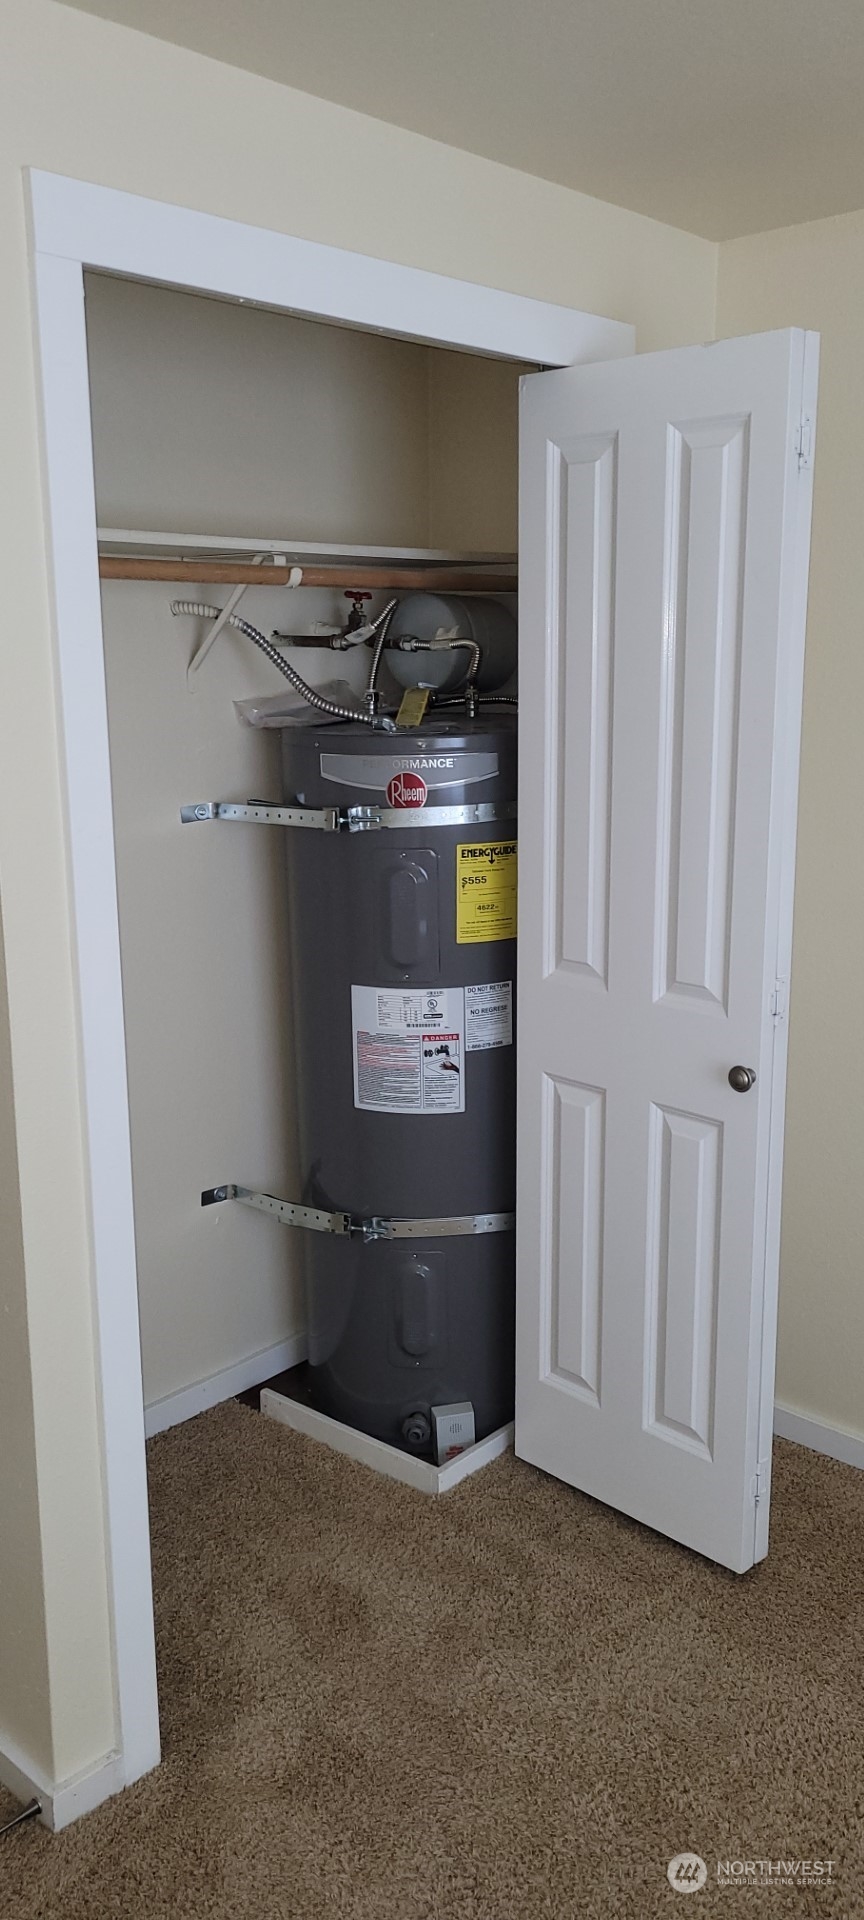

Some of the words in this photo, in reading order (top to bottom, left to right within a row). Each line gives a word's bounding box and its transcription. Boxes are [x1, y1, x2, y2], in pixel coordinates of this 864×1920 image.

[361, 758, 455, 769] PEORMANCE
[391, 773, 425, 806] Rheem
[461, 875, 487, 885] $555
[489, 982, 510, 991] RETURN
